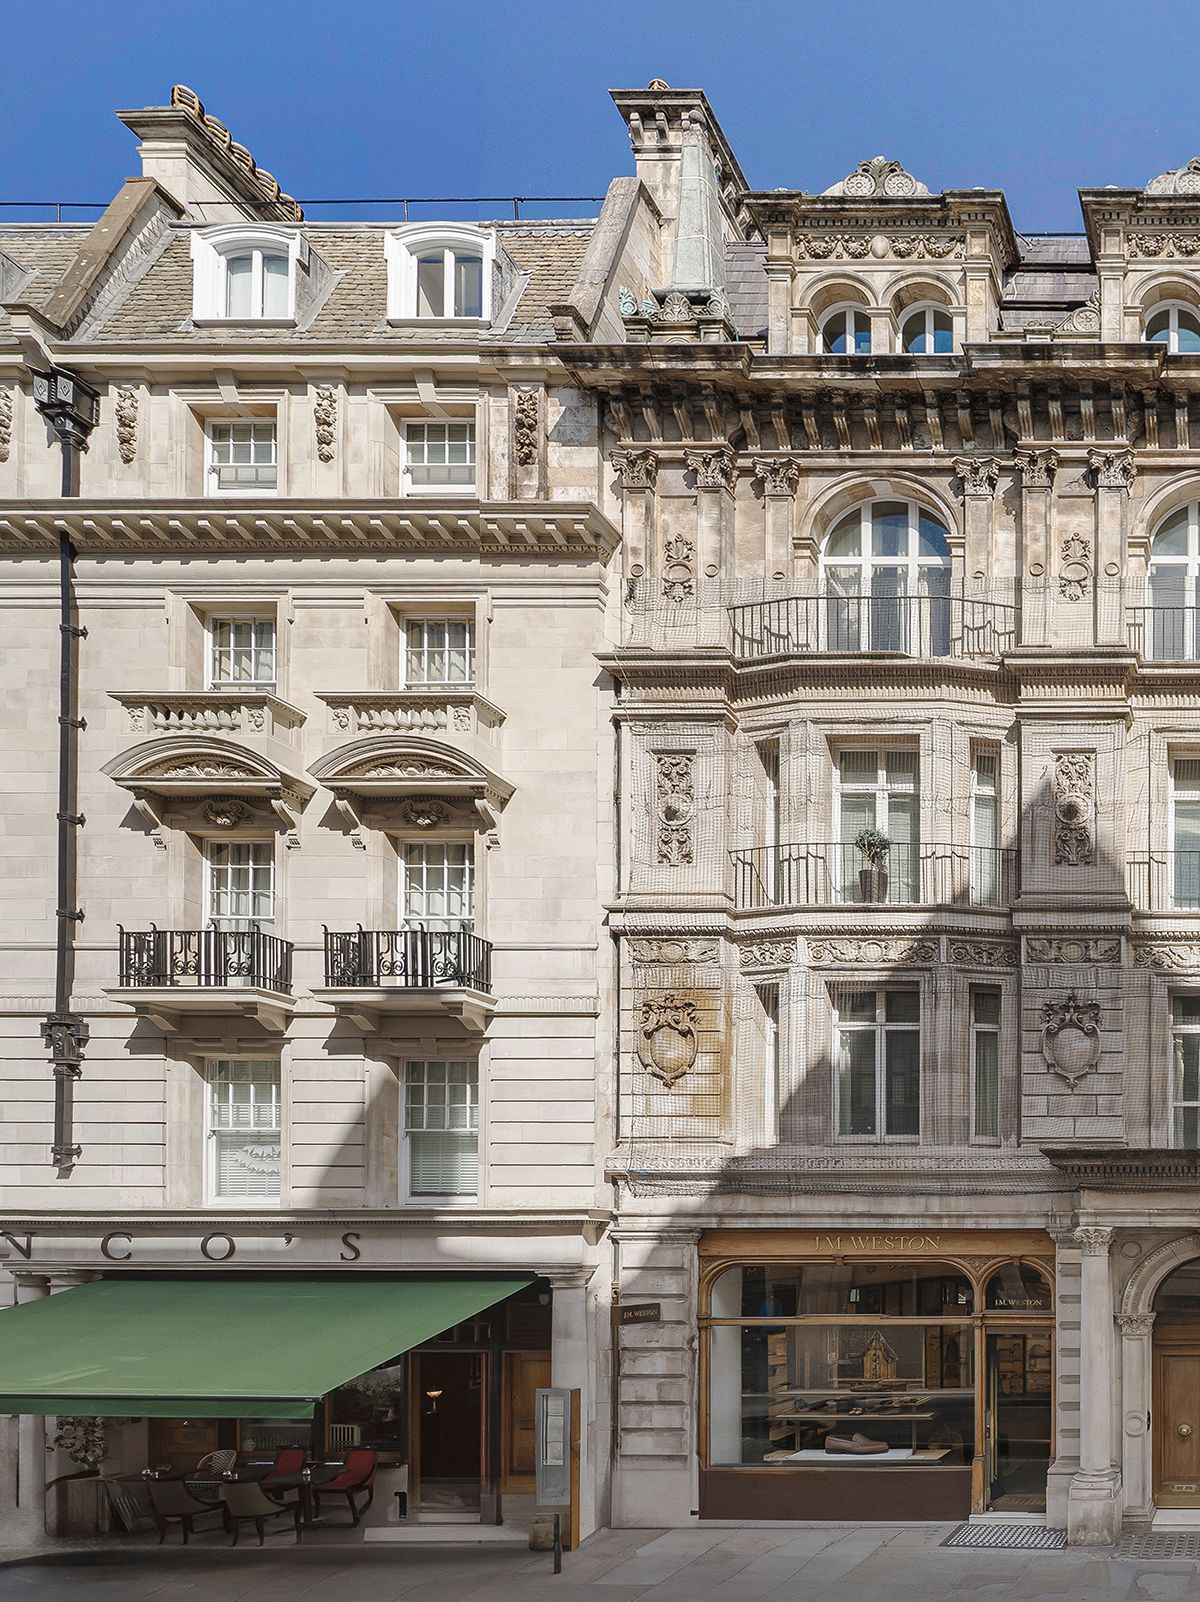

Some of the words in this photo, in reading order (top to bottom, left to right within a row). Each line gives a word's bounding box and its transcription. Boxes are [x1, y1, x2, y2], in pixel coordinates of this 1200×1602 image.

[814, 1236, 847, 1252] J.M.
[850, 1236, 941, 1251] WESTON
[633, 1309, 658, 1317] WESTON
